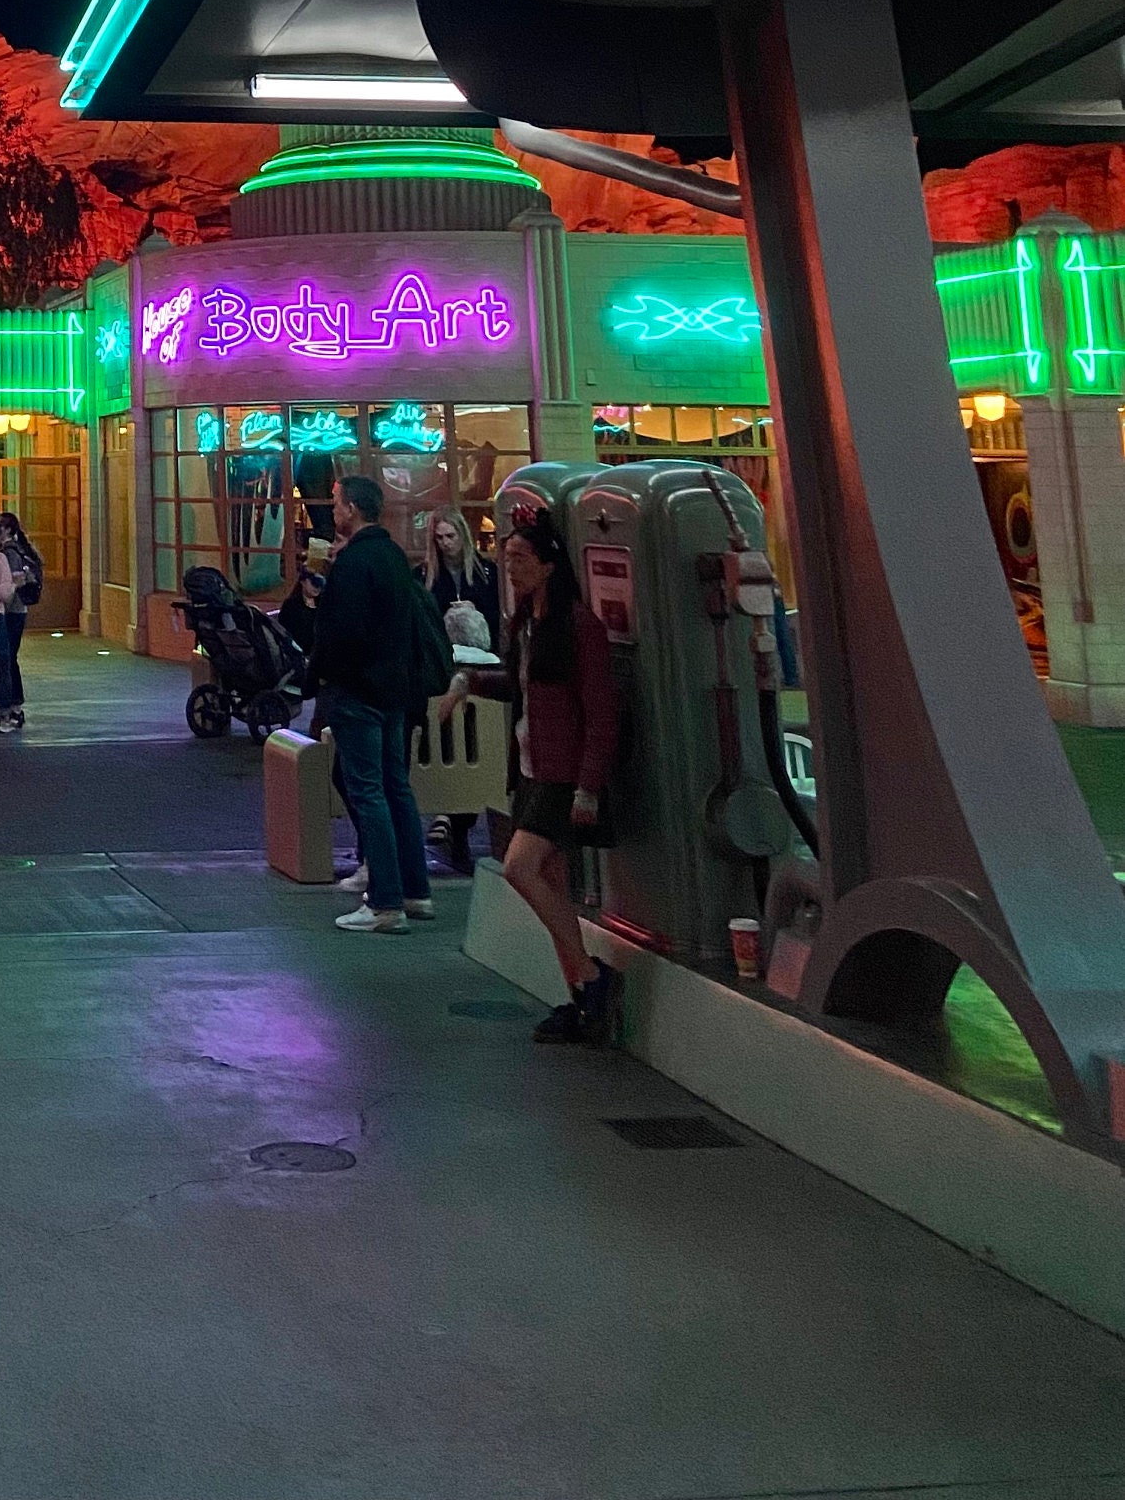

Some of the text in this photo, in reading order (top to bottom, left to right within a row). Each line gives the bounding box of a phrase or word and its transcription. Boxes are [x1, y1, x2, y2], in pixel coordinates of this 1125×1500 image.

[141, 286, 192, 356] House
[198, 273, 512, 360] Body Art
[158, 320, 184, 364] of
[303, 411, 352, 434] Jobs
[390, 404, 427, 424] Air
